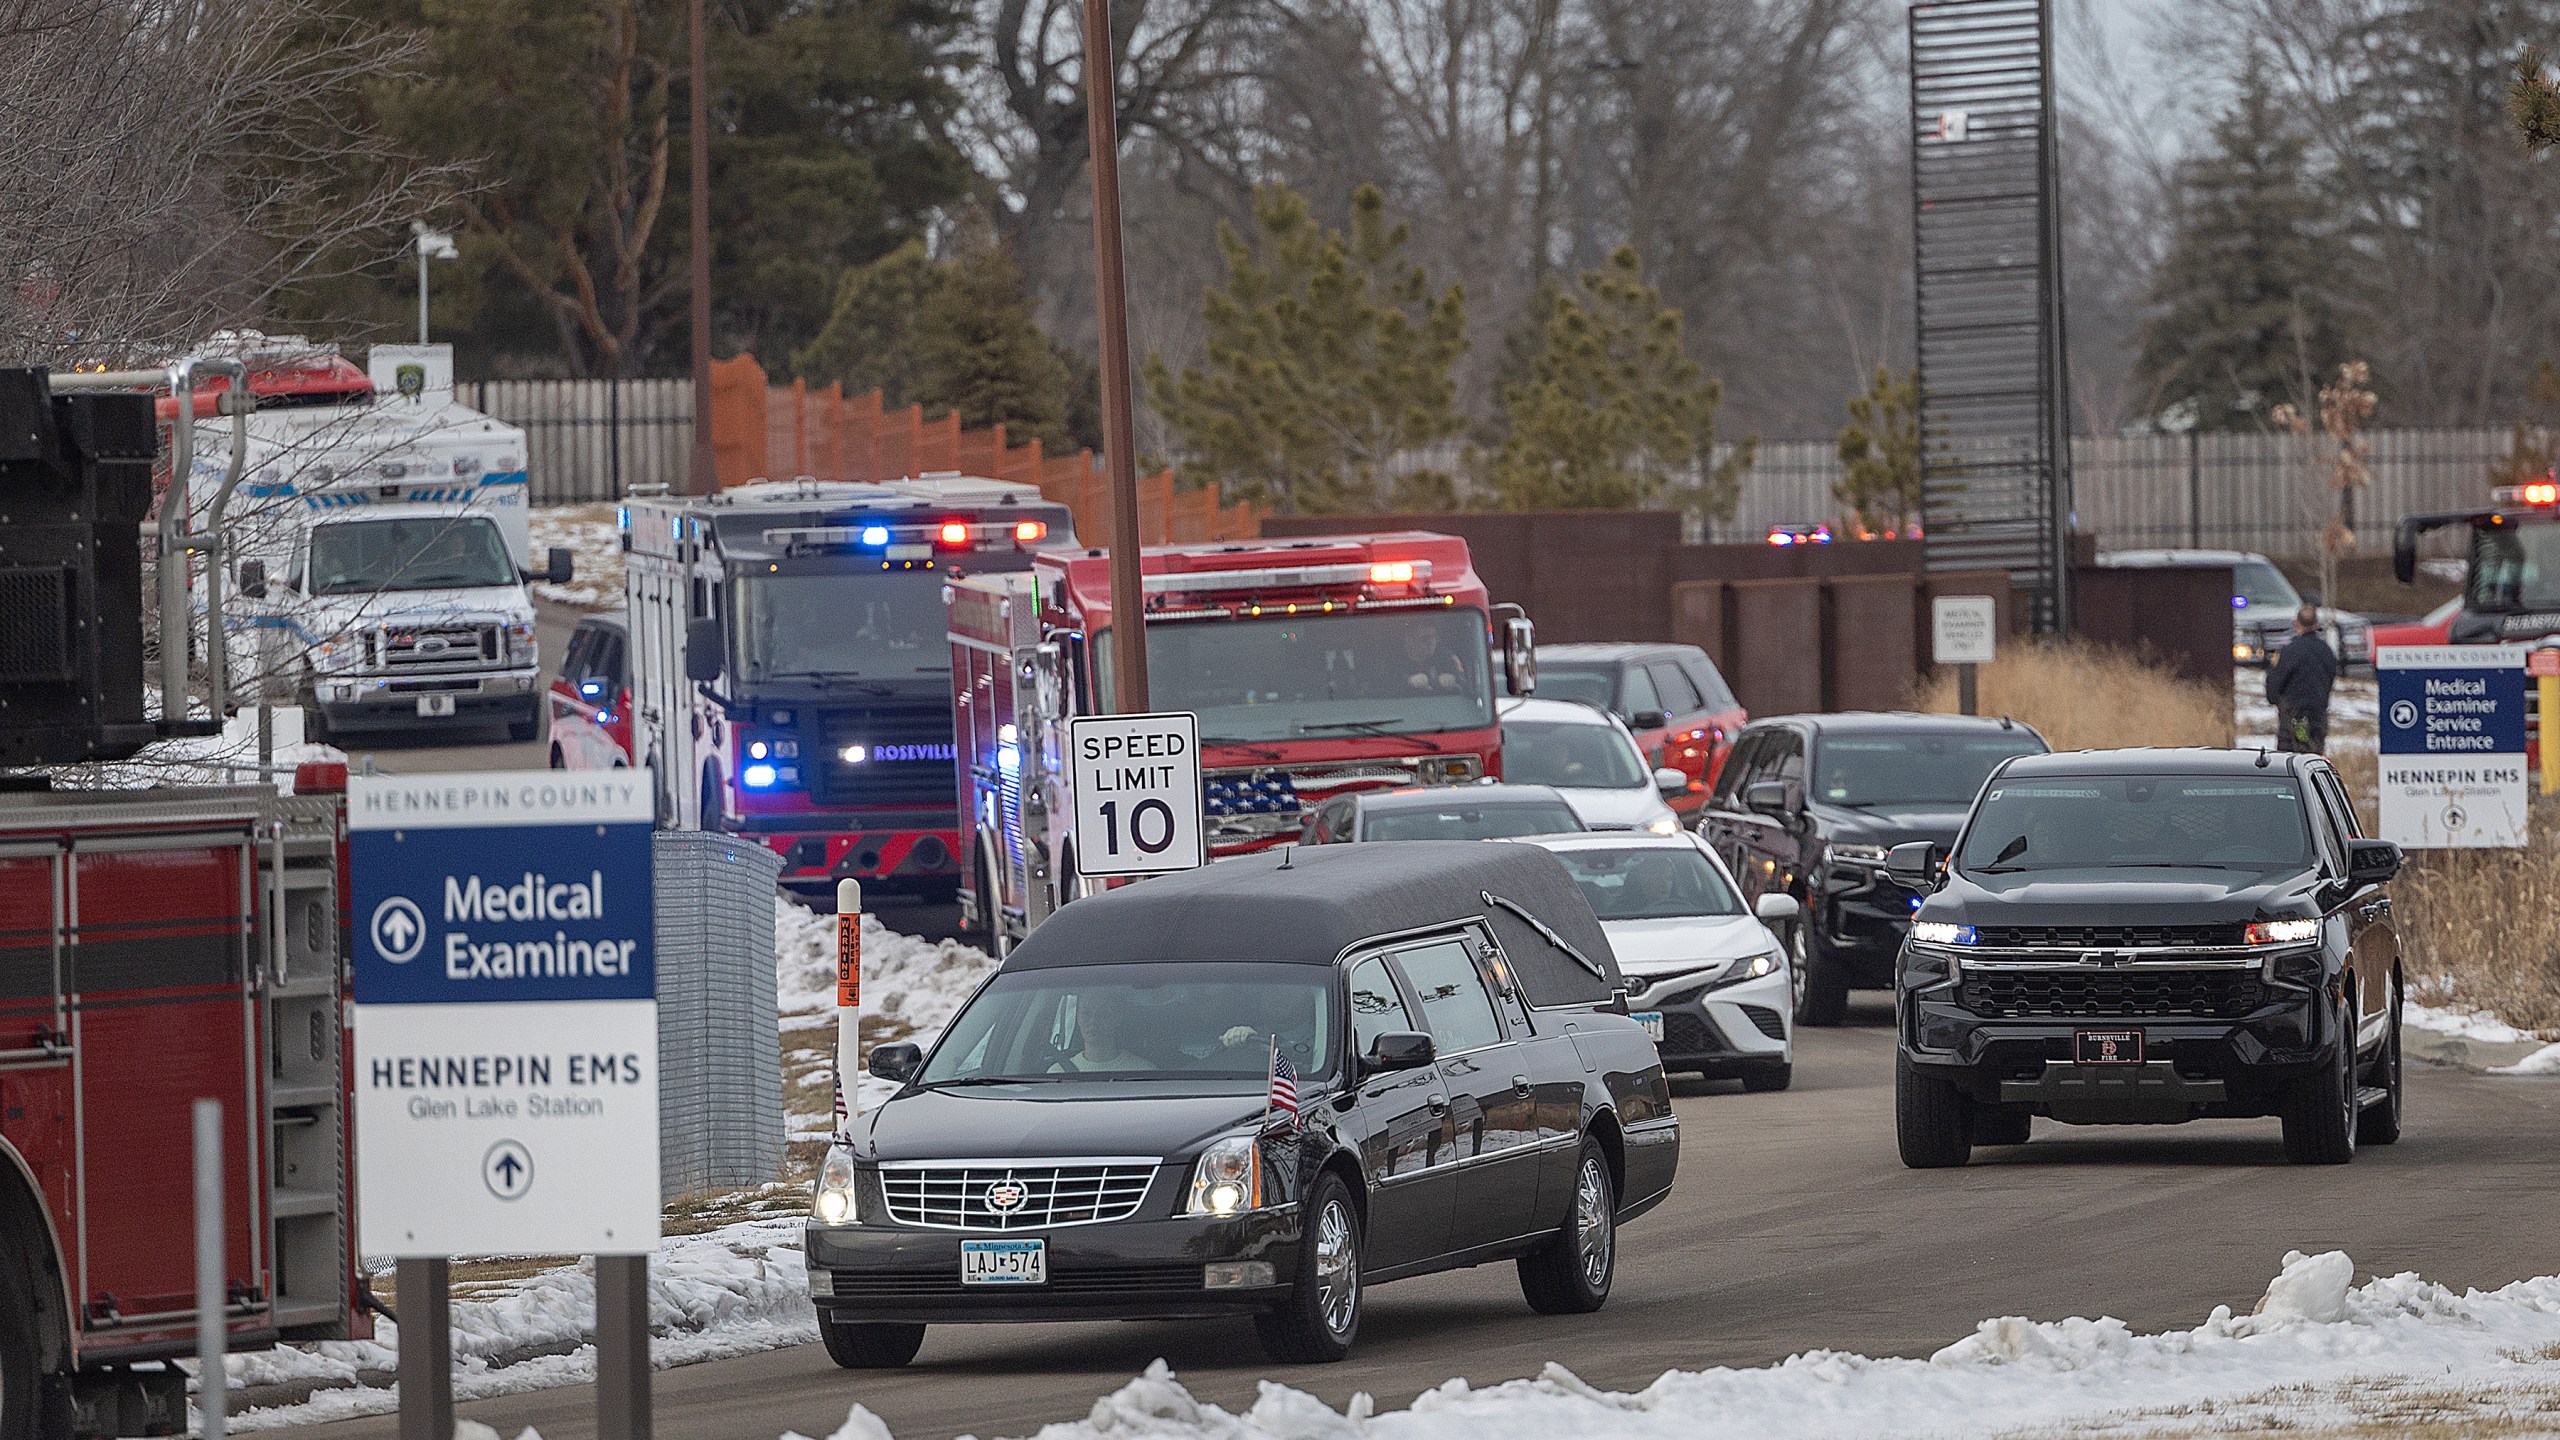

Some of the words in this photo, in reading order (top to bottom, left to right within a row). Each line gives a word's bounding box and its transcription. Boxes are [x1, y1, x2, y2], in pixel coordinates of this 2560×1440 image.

[2425, 678, 2486, 695] Medical
[2425, 697, 2498, 714] Examiner
[2425, 715, 2482, 732] Service
[1083, 734, 1185, 760] SPEED
[2426, 733, 2494, 750] Entrance
[1096, 766, 1175, 792] LIMIT
[2387, 769, 2477, 785] HENNEPIN
[2483, 768, 2519, 784] EMS
[365, 785, 510, 813] HENNEPIN
[519, 783, 635, 809] COUNTY
[1099, 798, 1175, 855] 10
[444, 869, 603, 923] Medical
[445, 930, 637, 980] Examiner
[841, 920, 850, 979] WARNING
[372, 1055, 552, 1088] HENNEPIN
[568, 1054, 642, 1085] EMS
[407, 1094, 457, 1119] Glen
[464, 1094, 518, 1118] Lake
[527, 1092, 604, 1118] Station
[983, 1242, 1022, 1251] Minnesota
[966, 1252, 998, 1274] LAJ
[1010, 1251, 1040, 1273] 574
